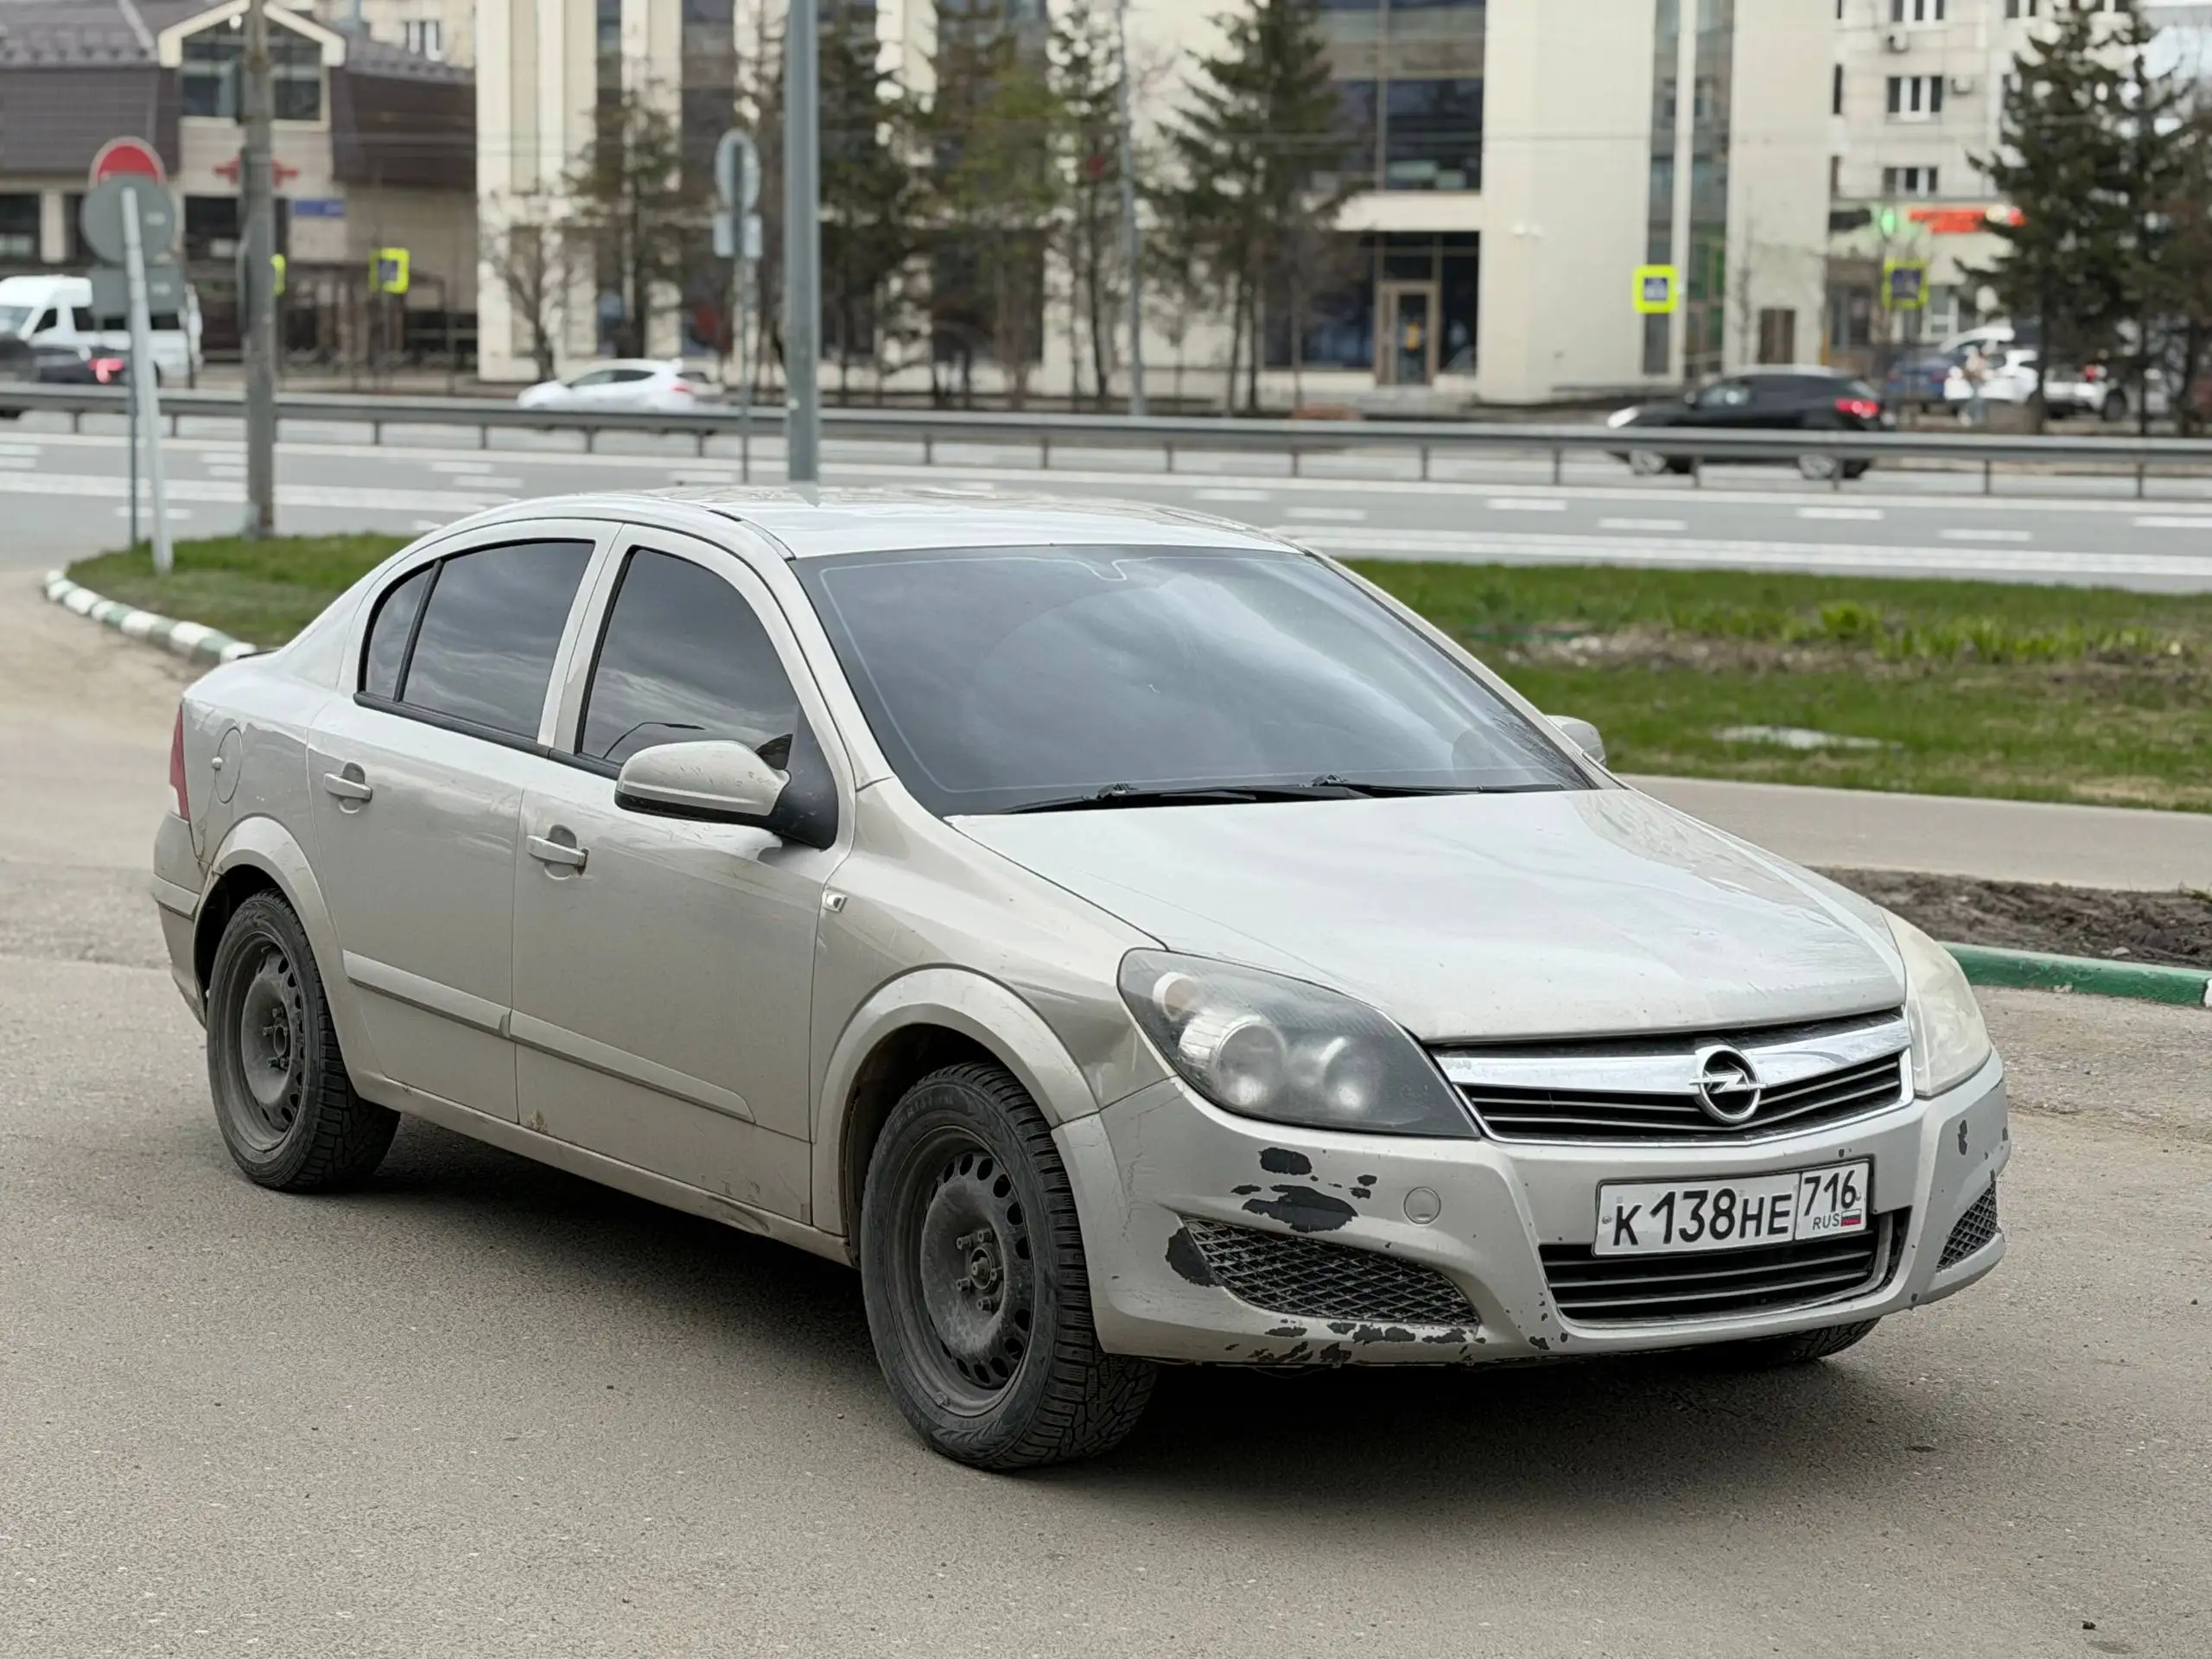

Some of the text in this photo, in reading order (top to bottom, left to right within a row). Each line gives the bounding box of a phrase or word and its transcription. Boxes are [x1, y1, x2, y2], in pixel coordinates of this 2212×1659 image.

[1613, 1169, 1855, 1246] К138НЕ 716
[1812, 1213, 1840, 1230] RUS
